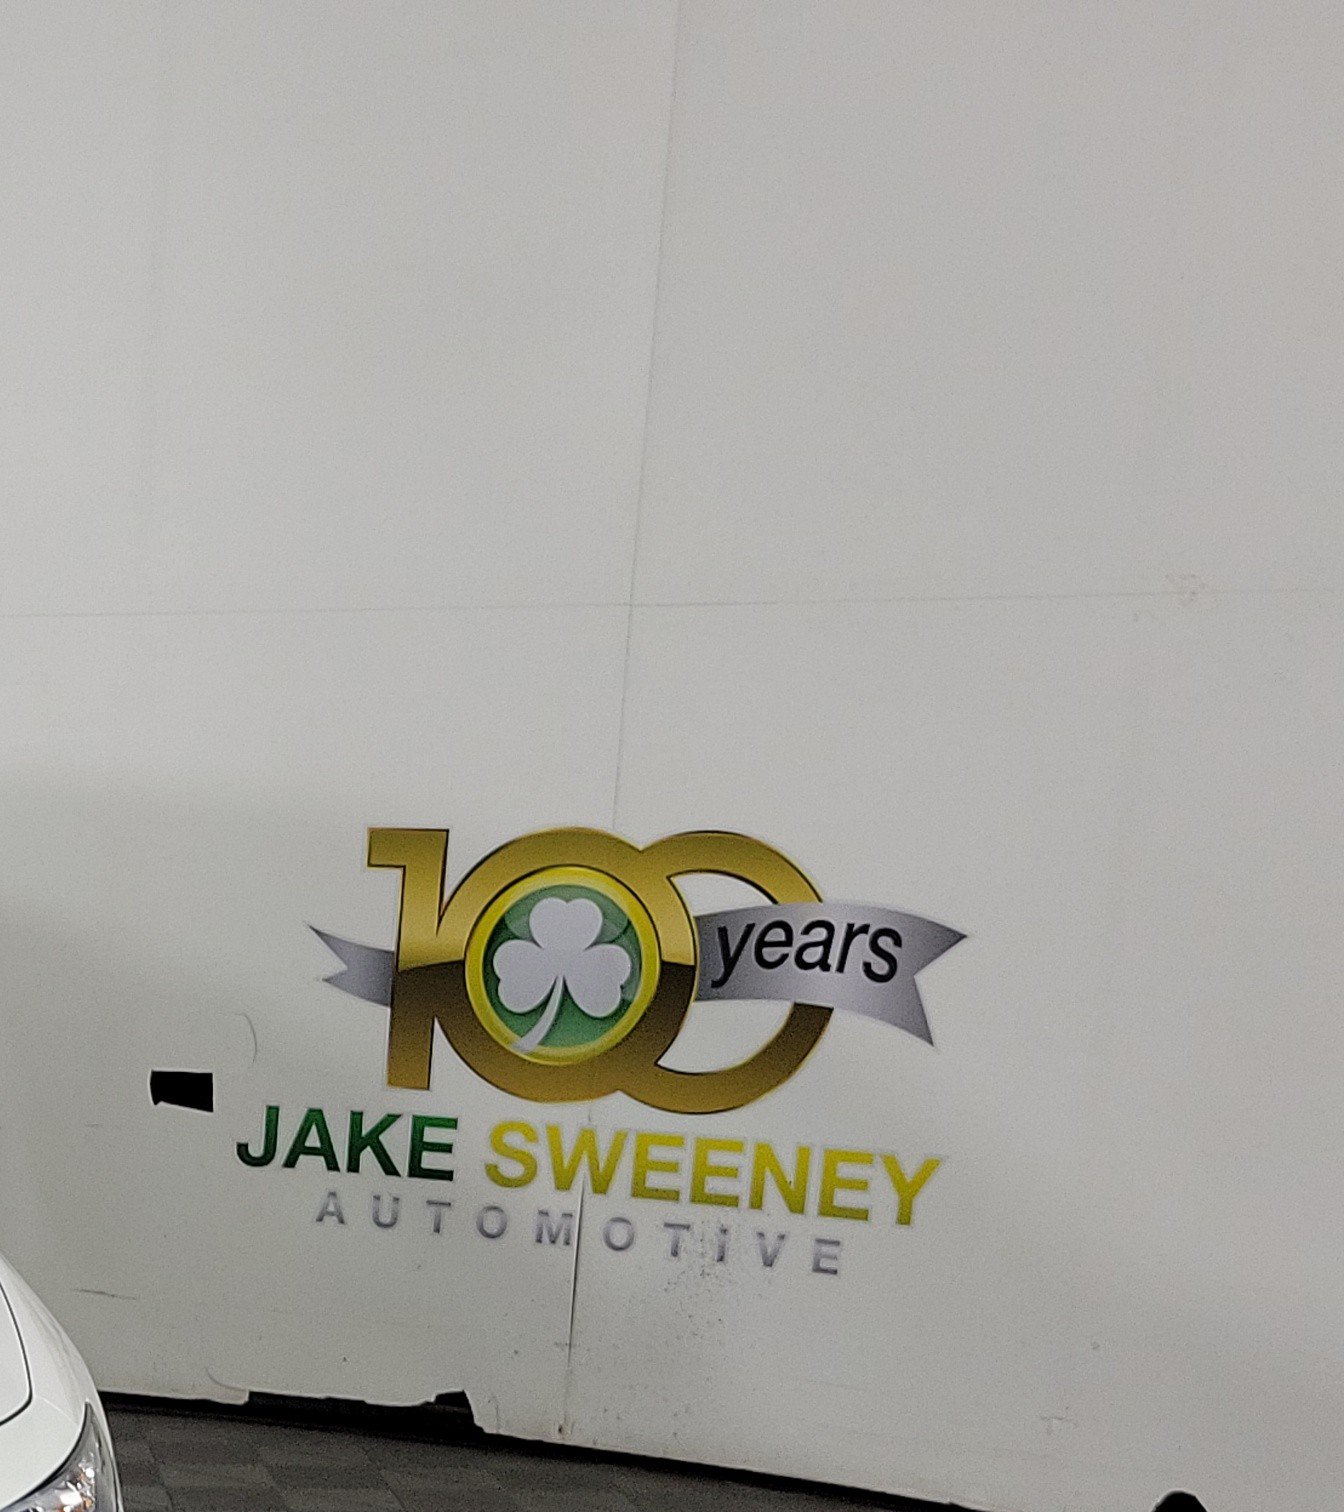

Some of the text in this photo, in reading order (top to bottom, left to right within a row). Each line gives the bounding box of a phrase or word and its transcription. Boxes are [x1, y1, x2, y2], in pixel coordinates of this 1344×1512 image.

[367, 827, 904, 1114] 100 years
[235, 1104, 942, 1226] JAKE SWEENEY
[315, 1191, 842, 1276] AUTOMOTIVE
